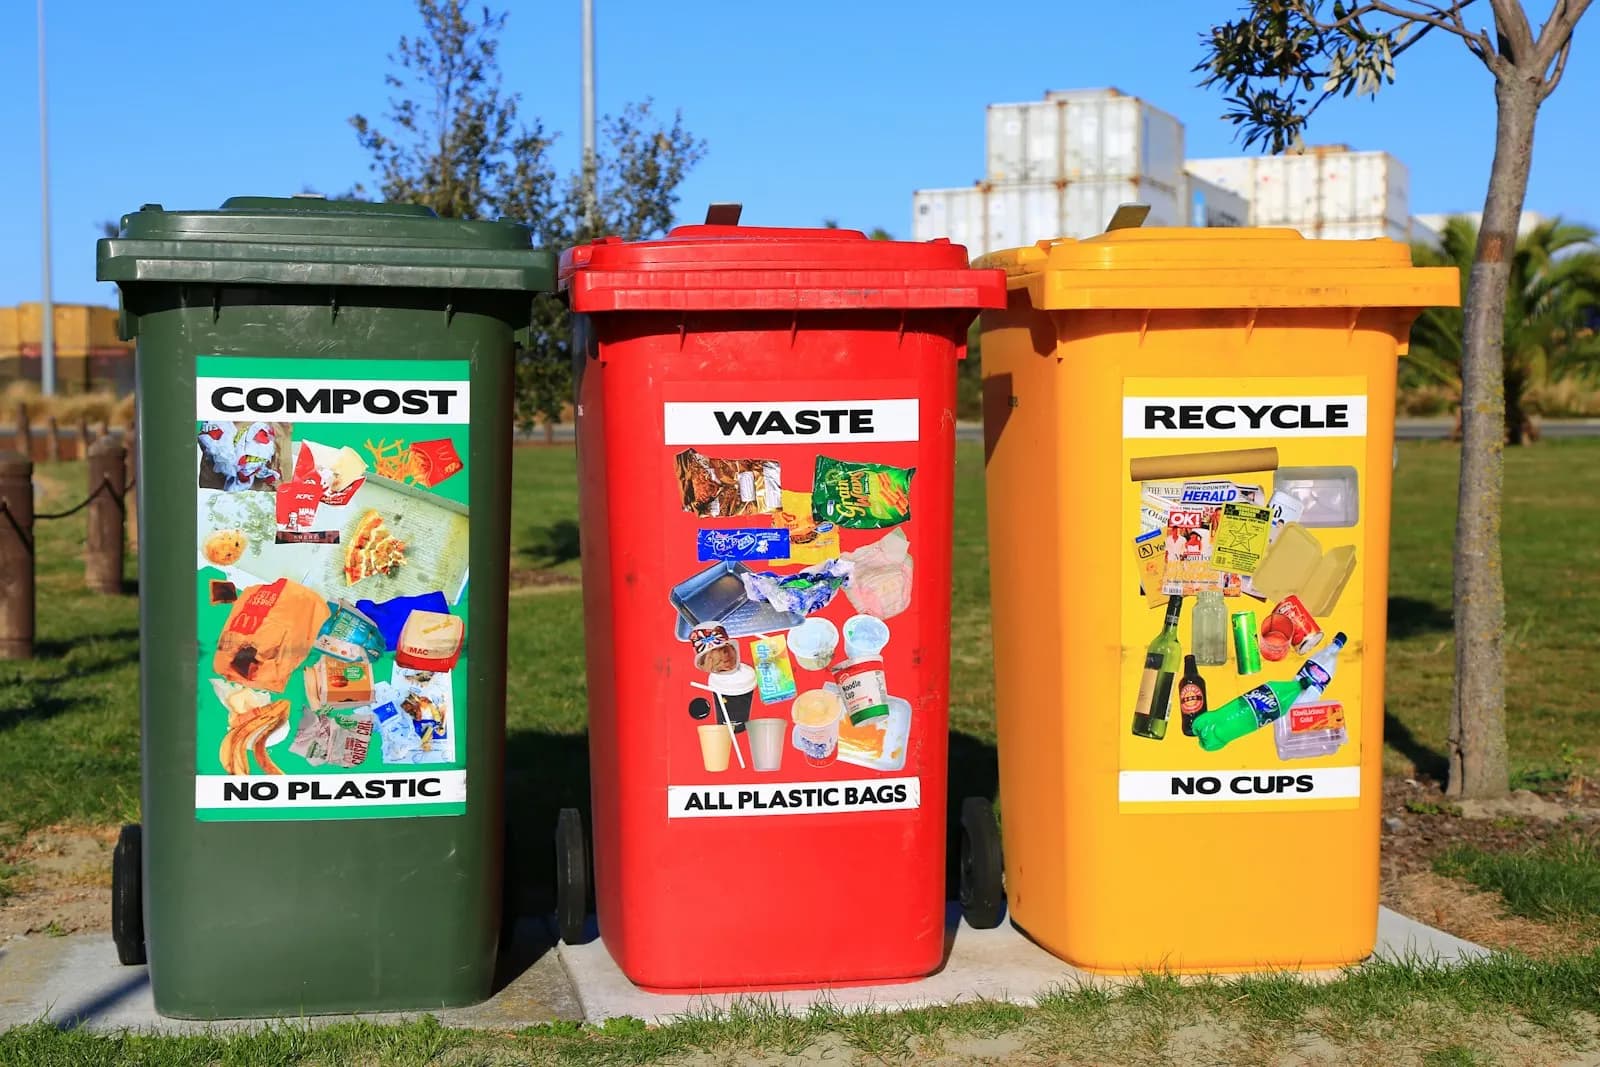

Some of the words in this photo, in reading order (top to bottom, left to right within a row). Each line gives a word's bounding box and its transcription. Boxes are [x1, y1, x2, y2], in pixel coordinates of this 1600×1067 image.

[211, 387, 458, 415] COMPOST
[713, 409, 875, 436] WASTE
[1144, 404, 1349, 430] RECYCLE
[295, 493, 315, 501] KFC
[1147, 487, 1161, 495] THE
[1182, 489, 1237, 502] HERALD
[1170, 512, 1200, 526] OK!
[408, 647, 429, 656] MAC
[841, 680, 861, 692] Noodle
[1245, 688, 1278, 708] Sprite
[351, 738, 368, 765] CRISPY
[223, 782, 279, 801] NO
[287, 777, 441, 800] PLASTIC
[1171, 776, 1222, 795] NO
[1229, 774, 1314, 794] CUPS
[684, 792, 732, 811] ALL
[738, 787, 839, 809] PLASTIC
[844, 784, 907, 806] BAGS
